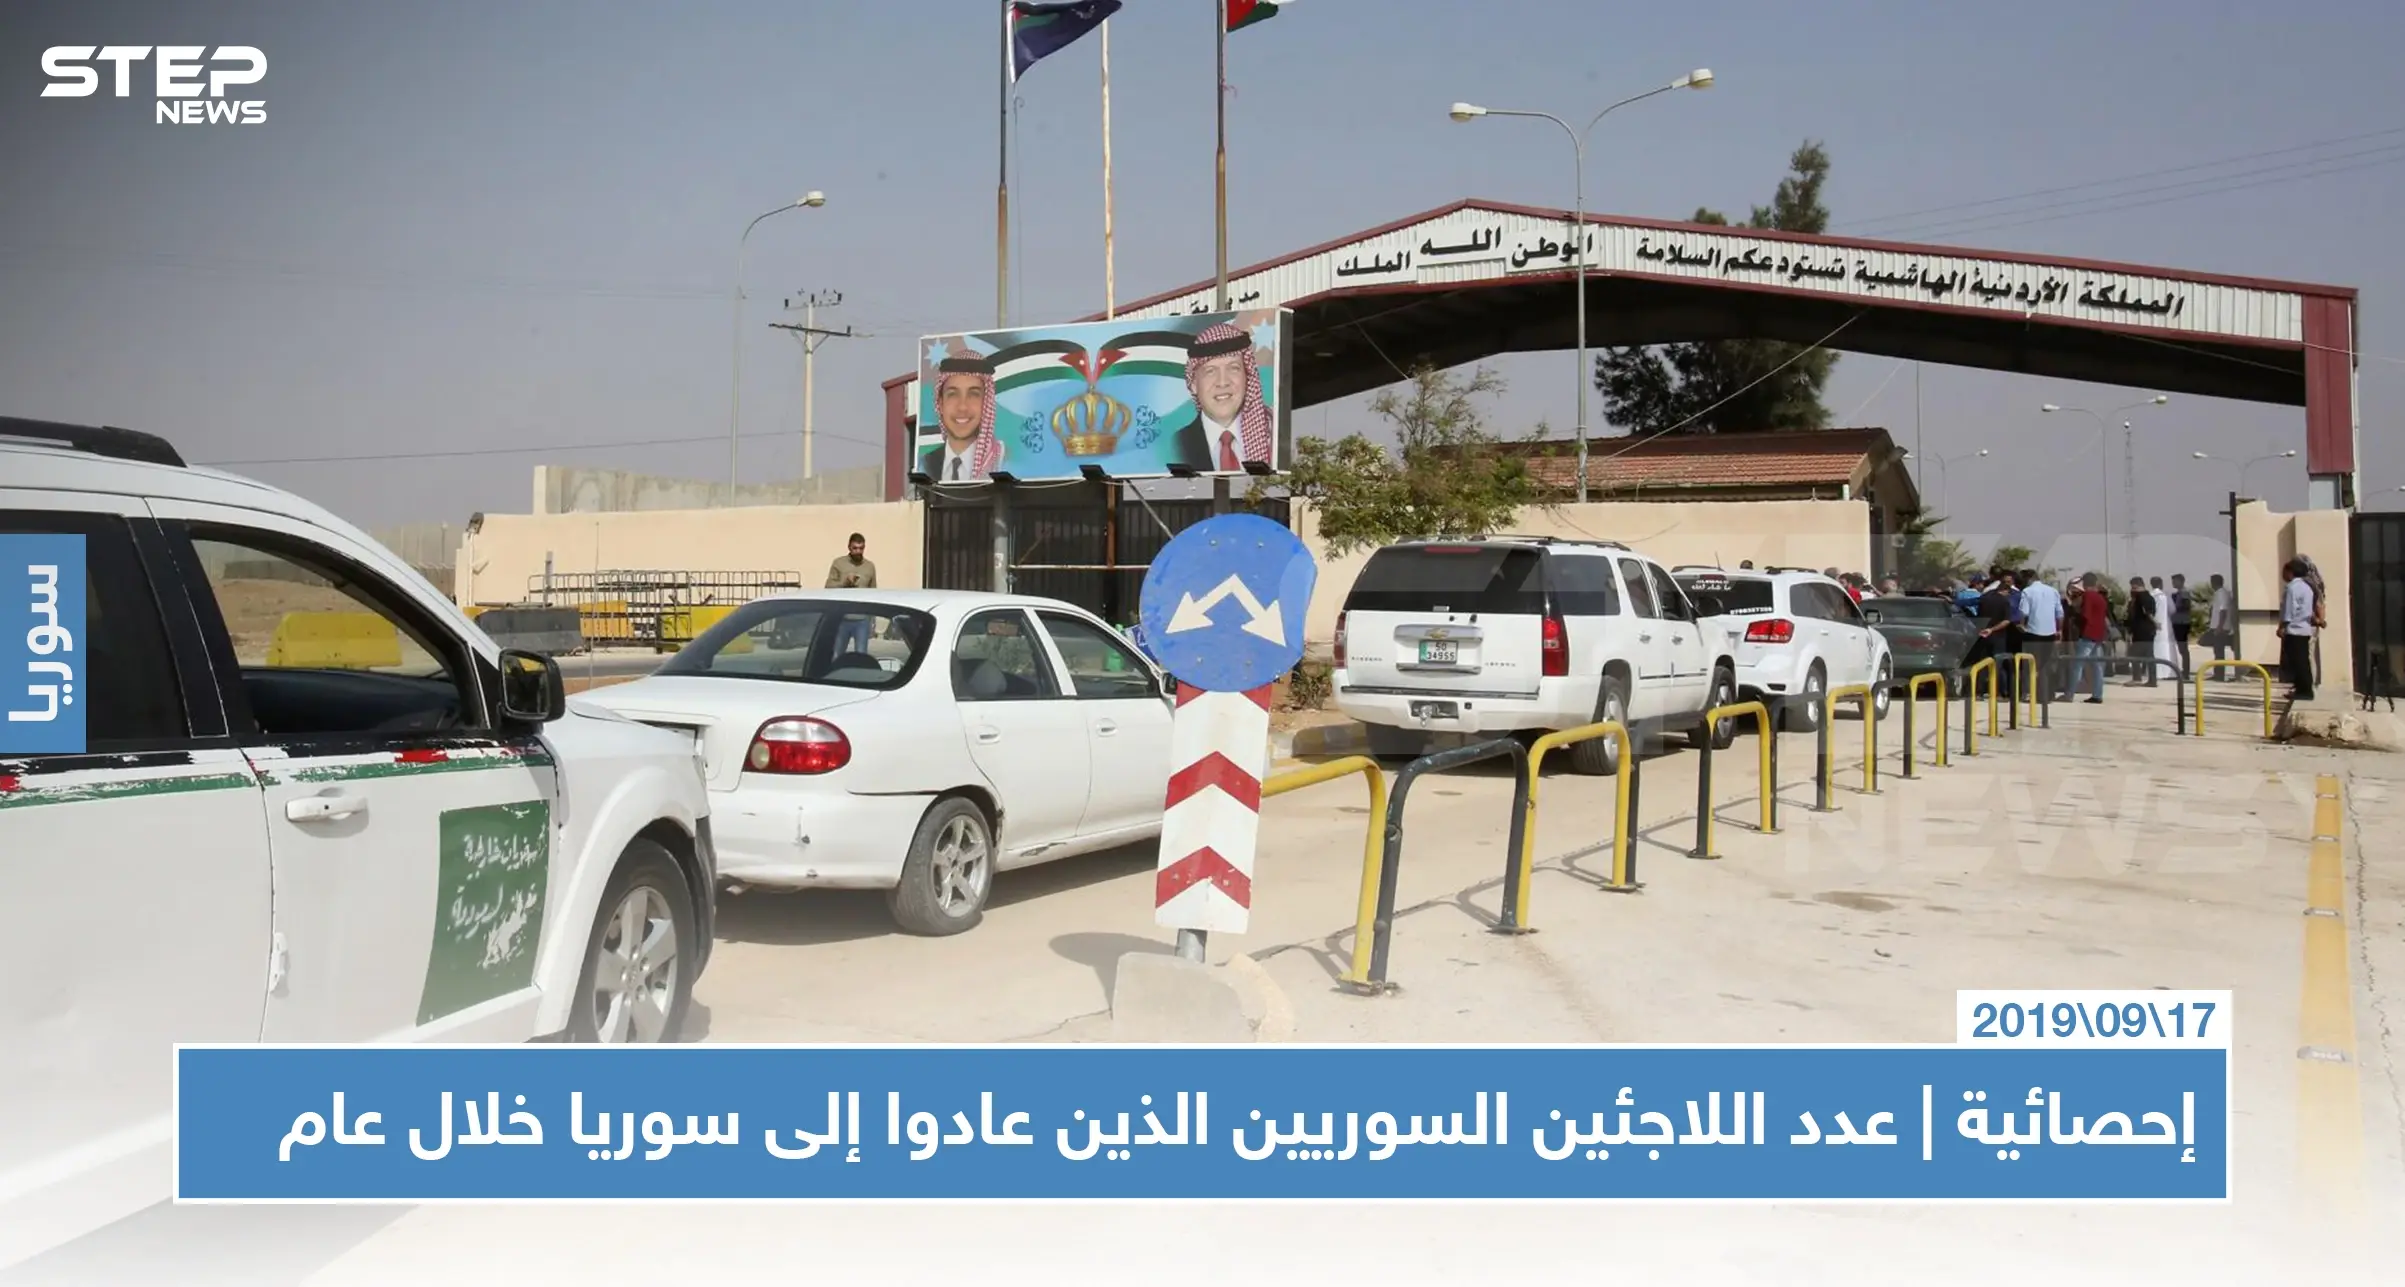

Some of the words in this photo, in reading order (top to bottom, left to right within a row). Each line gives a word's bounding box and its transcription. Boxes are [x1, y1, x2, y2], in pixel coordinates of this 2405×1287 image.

[1420, 226, 1501, 255] الله
[1636, 237, 1721, 268] السلامة
[1336, 250, 1410, 277] الملك
[1854, 259, 1967, 300] الهاشمية
[1970, 267, 2069, 307] الأردنية
[2078, 280, 2185, 319] المملكة
[1427, 651, 1455, 661] 34955
